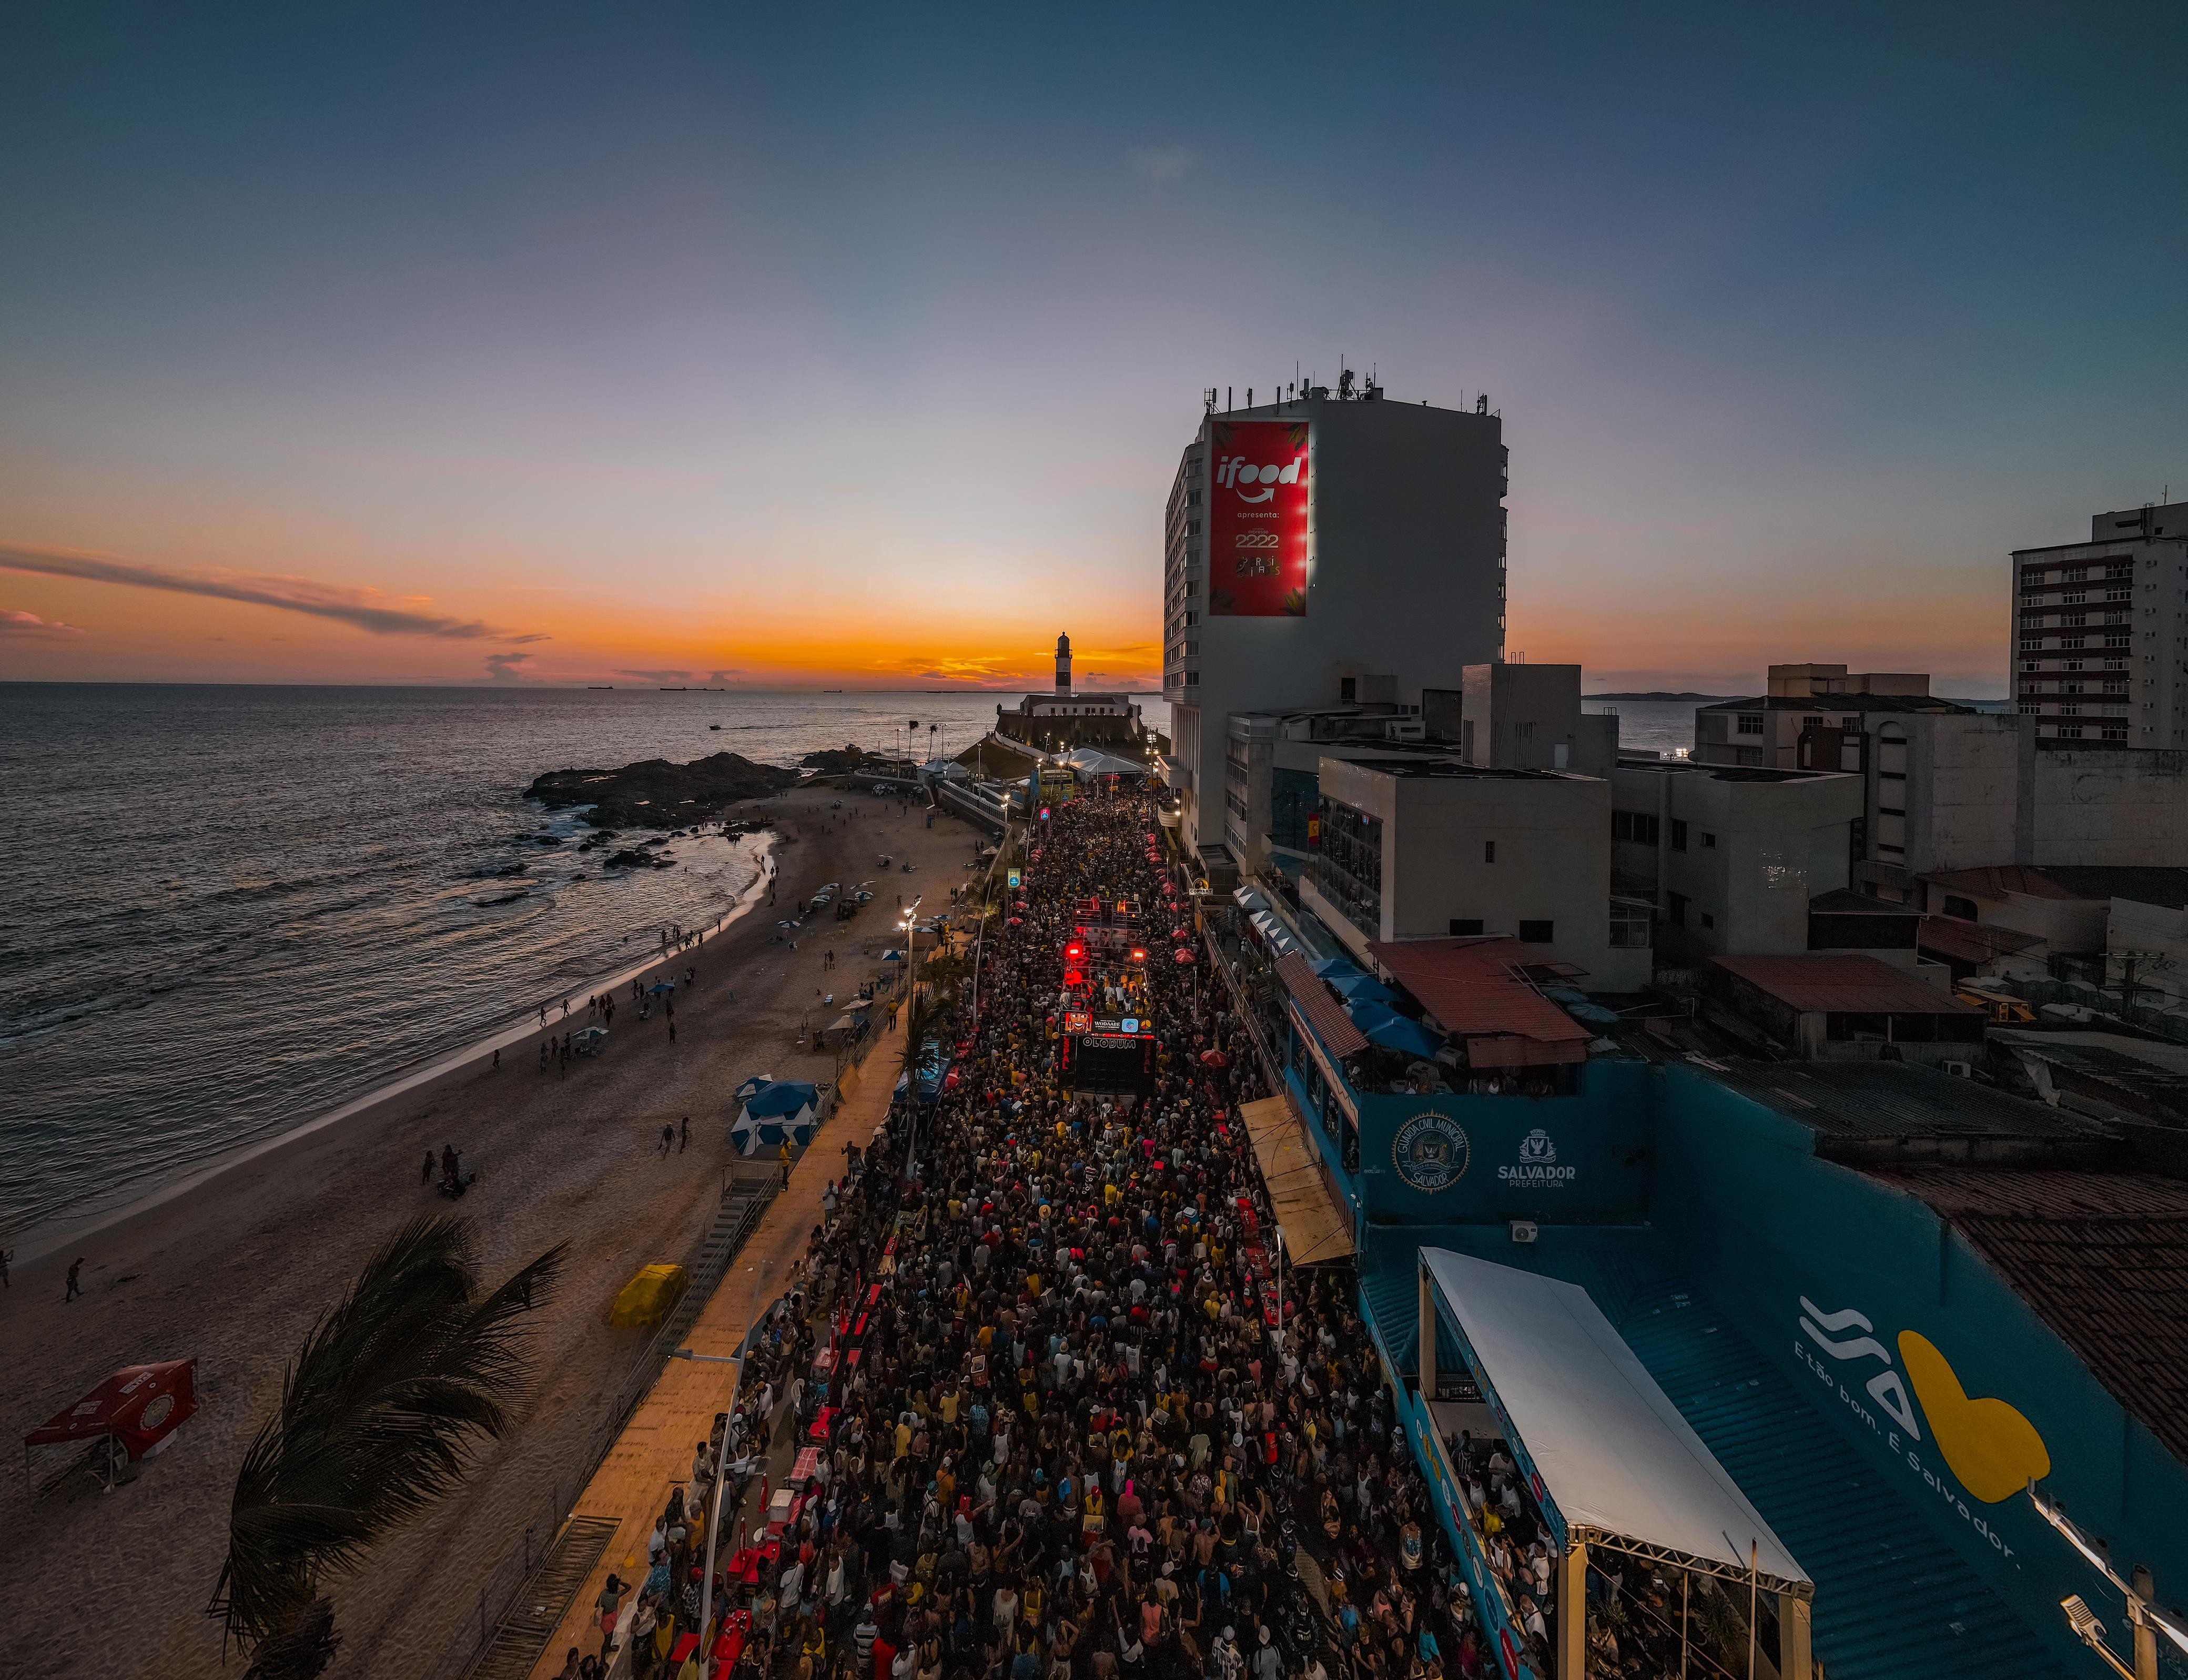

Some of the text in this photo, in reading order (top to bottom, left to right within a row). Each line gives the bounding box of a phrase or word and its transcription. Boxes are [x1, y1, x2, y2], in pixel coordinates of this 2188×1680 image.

[1217, 456, 1302, 489] ifood
[1235, 534, 1279, 548] 2222
[1083, 1037, 1136, 1049] OLODUM
[1397, 1118, 1466, 1153] GUARDA CIVIL MUNICIPAL
[1411, 1172, 1449, 1187] SALVADOR
[1497, 1166, 1576, 1179] SALVADOR
[1840, 1384, 1881, 1435] bom.
